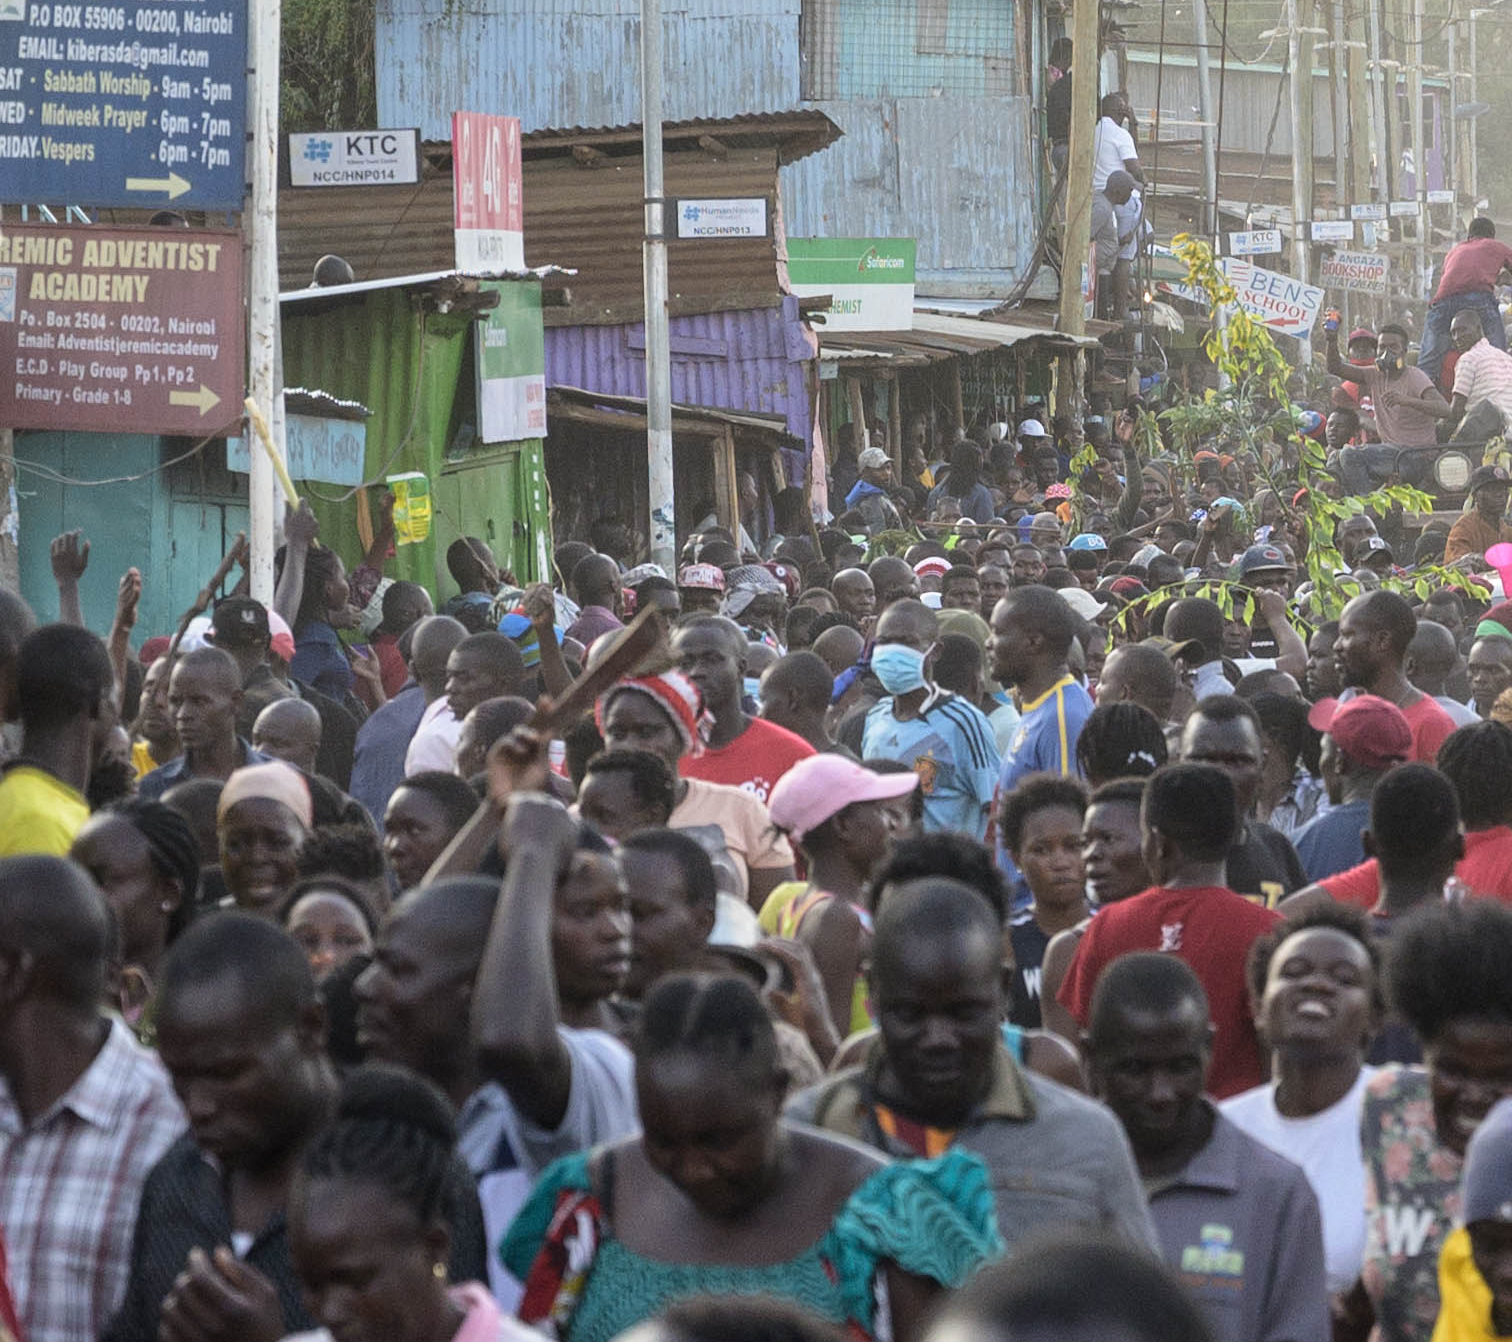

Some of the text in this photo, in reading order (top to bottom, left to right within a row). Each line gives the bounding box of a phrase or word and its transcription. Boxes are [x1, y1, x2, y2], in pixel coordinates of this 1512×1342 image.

[53, 5, 82, 29] BOX
[85, 6, 125, 31] 55906
[183, 11, 233, 35] Nairobi
[18, 36, 210, 69] EMAIL: kiberasda@gmail.com
[44, 70, 96, 94] Sabbath
[99, 71, 152, 101] Worship
[161, 75, 191, 99] 9am
[202, 77, 232, 105] 5pm
[41, 103, 100, 128] Midweek
[104, 105, 148, 134] Prayer
[160, 110, 189, 138] 6pm
[201, 112, 231, 141] 7pm
[159, 140, 188, 167] 6pm
[200, 141, 230, 170] 7pm
[346, 135, 398, 156] KTC
[313, 168, 396, 183] NCC/HNP014
[1251, 231, 1274, 244] KTC
[82, 240, 222, 272] ADVENTIST
[866, 255, 905, 268] Safaricom
[1321, 261, 1384, 280] BOOKSHOP
[29, 272, 150, 304] ACADEMY
[1249, 271, 1322, 310] BENS
[828, 299, 863, 315] HEMIST
[1241, 289, 1310, 323] SCHOOL
[46, 311, 72, 328] Box
[168, 318, 216, 335] Nairobi
[18, 331, 219, 360] Email: Adventistjeremicacademy
[59, 360, 85, 380] Play
[90, 361, 128, 381] Group
[15, 383, 62, 406] Primary
[72, 386, 110, 405] Grade
